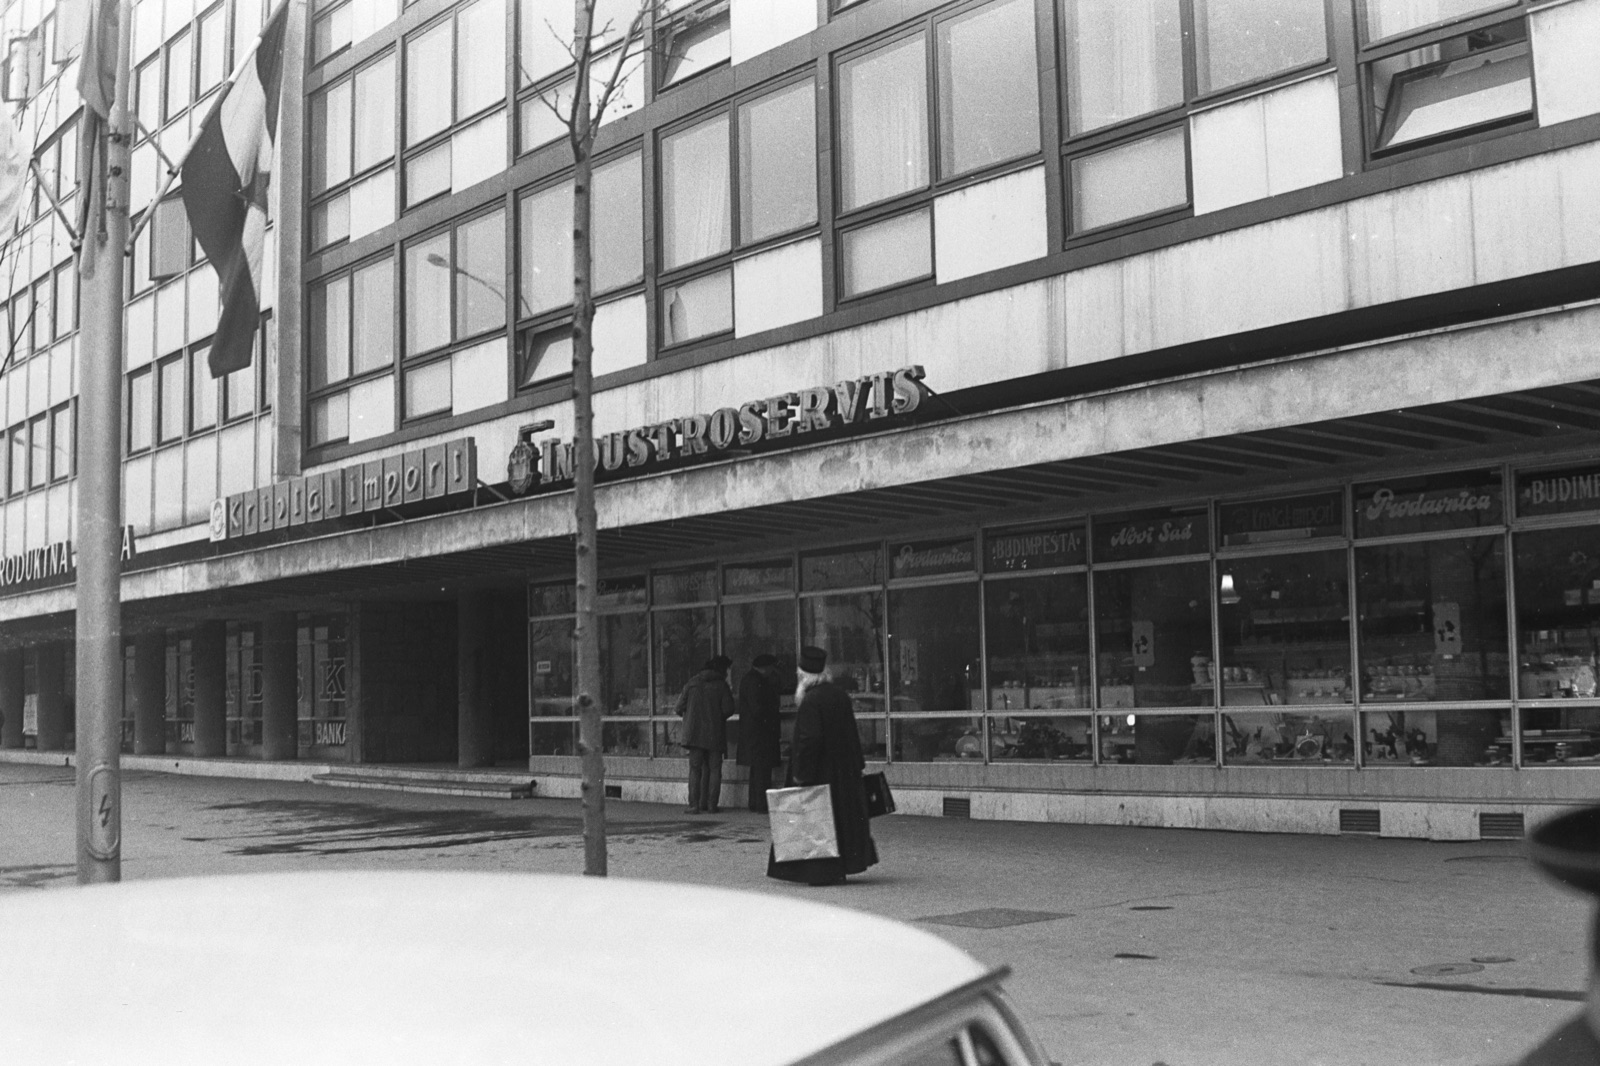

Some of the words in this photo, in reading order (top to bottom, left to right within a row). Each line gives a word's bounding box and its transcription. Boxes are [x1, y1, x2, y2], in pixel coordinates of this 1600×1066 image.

[1366, 488, 1491, 520] Prodavnica
[1110, 526, 1154, 547] Novi
[1158, 521, 1193, 543] Sad
[895, 544, 972, 569] Prodavnica
